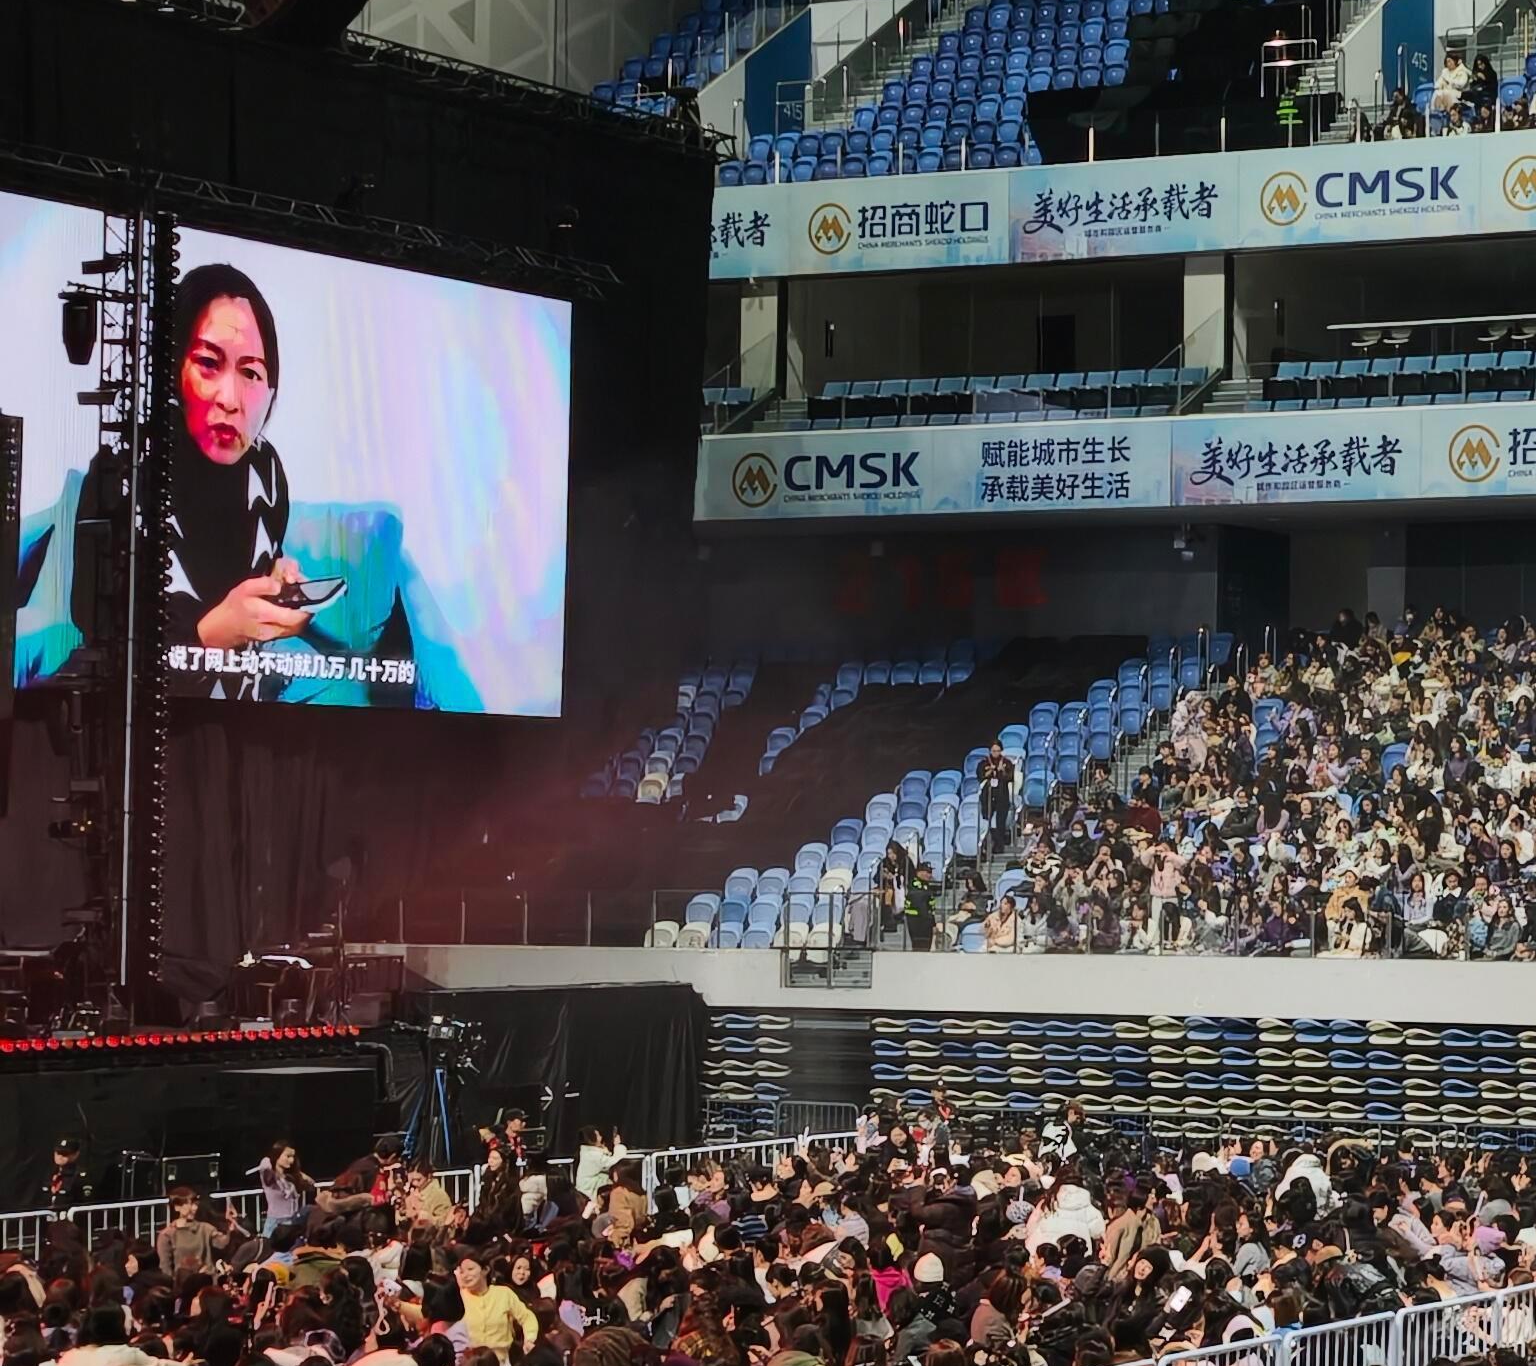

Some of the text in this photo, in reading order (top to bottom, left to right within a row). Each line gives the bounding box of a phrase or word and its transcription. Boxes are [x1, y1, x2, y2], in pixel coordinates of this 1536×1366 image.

[1315, 165, 1459, 208] CMSK
[858, 200, 989, 238] 招商蛇口
[1022, 181, 1219, 235] 美好生活承载者
[711, 211, 771, 248] 载者
[783, 451, 920, 491] CMSK
[980, 437, 1131, 468] 赋能城市生长
[1190, 435, 1403, 487] 美好生活承载者
[980, 472, 1131, 503] 承载美好生活
